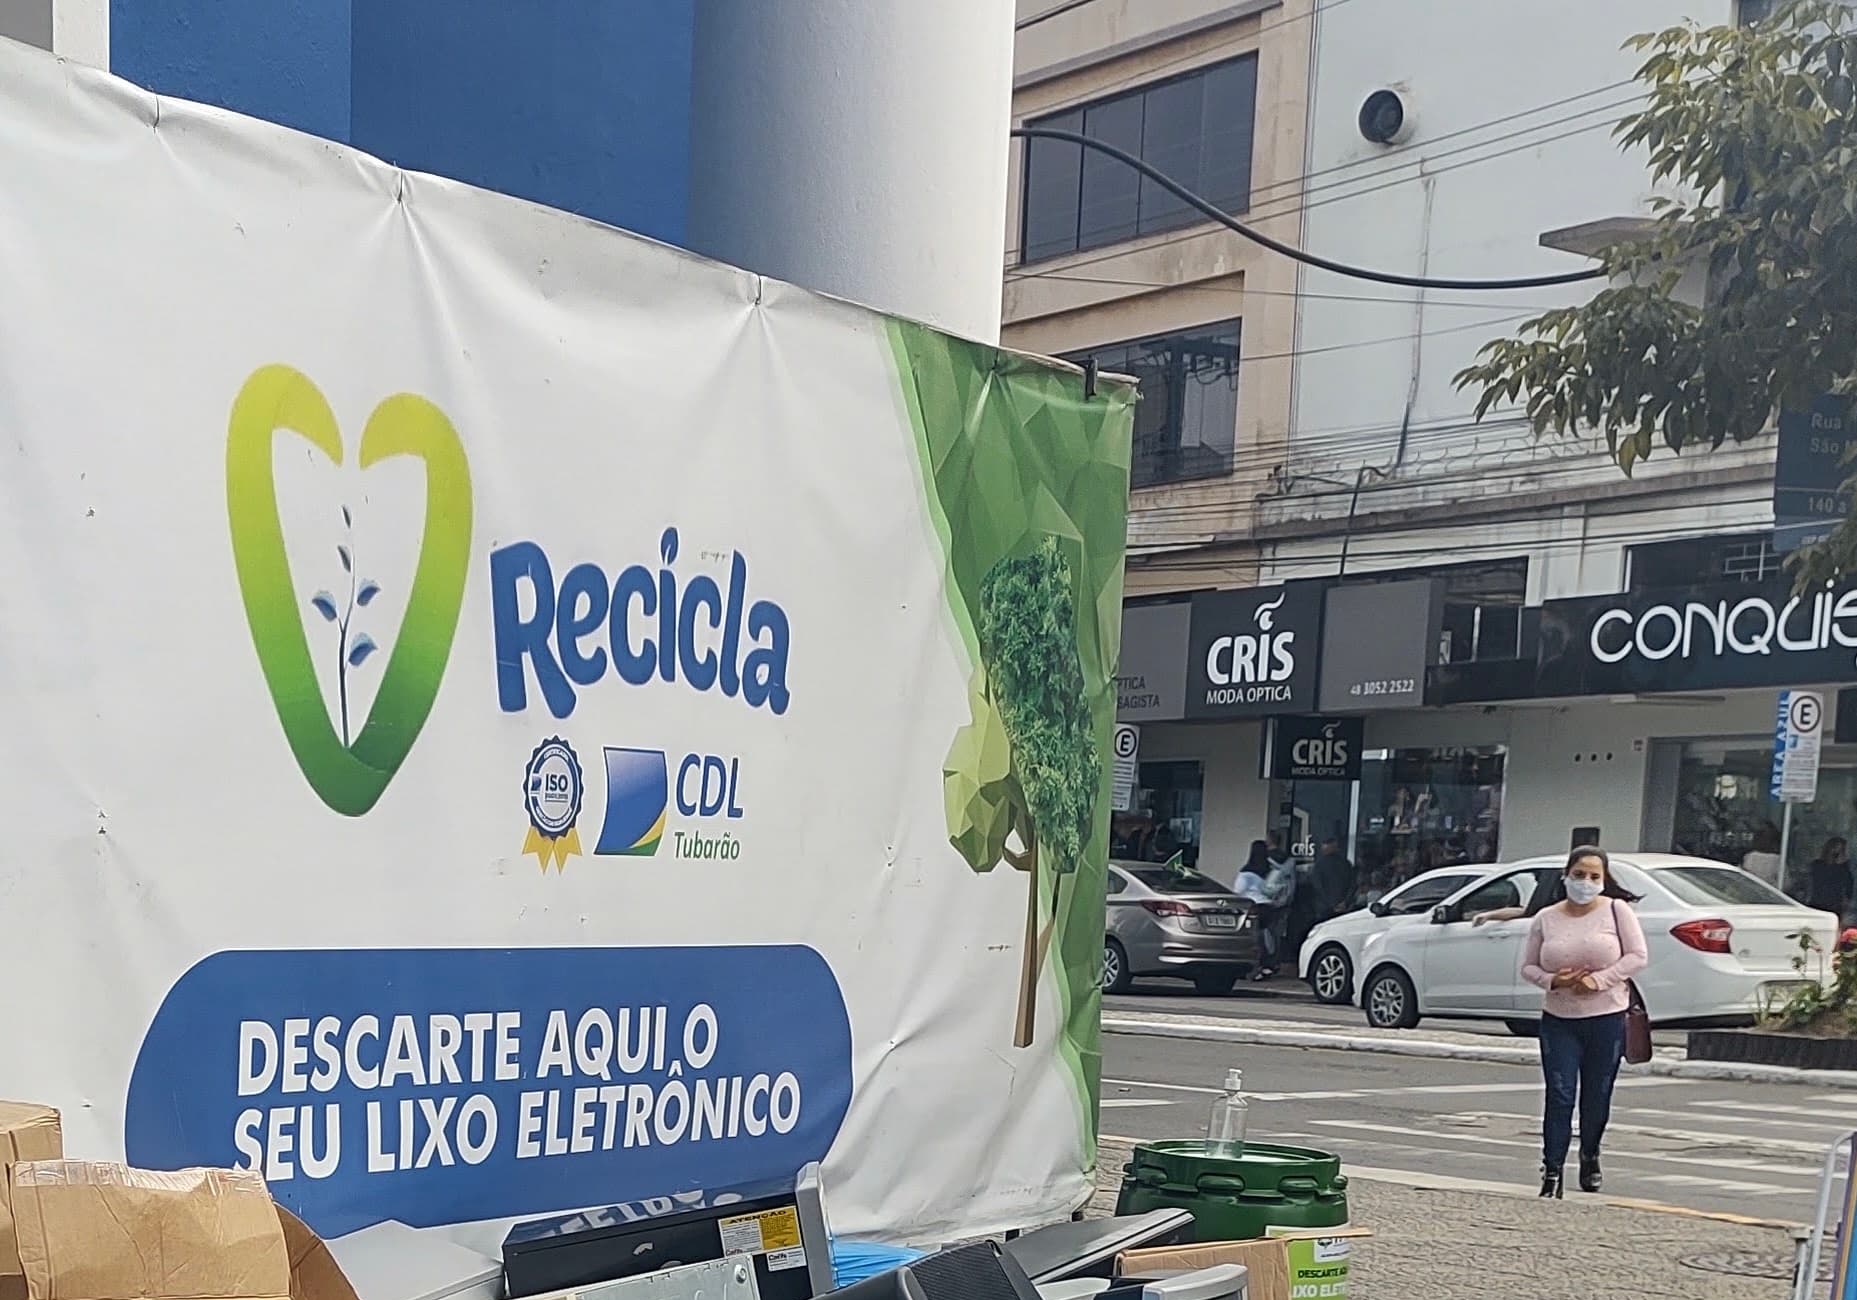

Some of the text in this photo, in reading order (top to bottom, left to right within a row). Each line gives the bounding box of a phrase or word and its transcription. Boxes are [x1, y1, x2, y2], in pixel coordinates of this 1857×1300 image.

[1811, 413, 1842, 430] Rua
[1808, 498, 1834, 513] 140
[490, 527, 791, 719] Recicla
[1207, 610, 1295, 685] CRIS
[1206, 684, 1292, 705] MODA OPTICA
[1363, 680, 1387, 696] 3052
[1389, 679, 1415, 693] 2522
[1800, 703, 1812, 725] E
[1293, 727, 1347, 767] CRIS
[545, 773, 569, 792] ISO
[676, 754, 744, 818] CDL
[674, 831, 741, 861] Tubarão
[237, 1003, 719, 1098] DESCARTE AQUI O
[233, 1058, 801, 1182] SEU LIXO ELETRÔNICO
